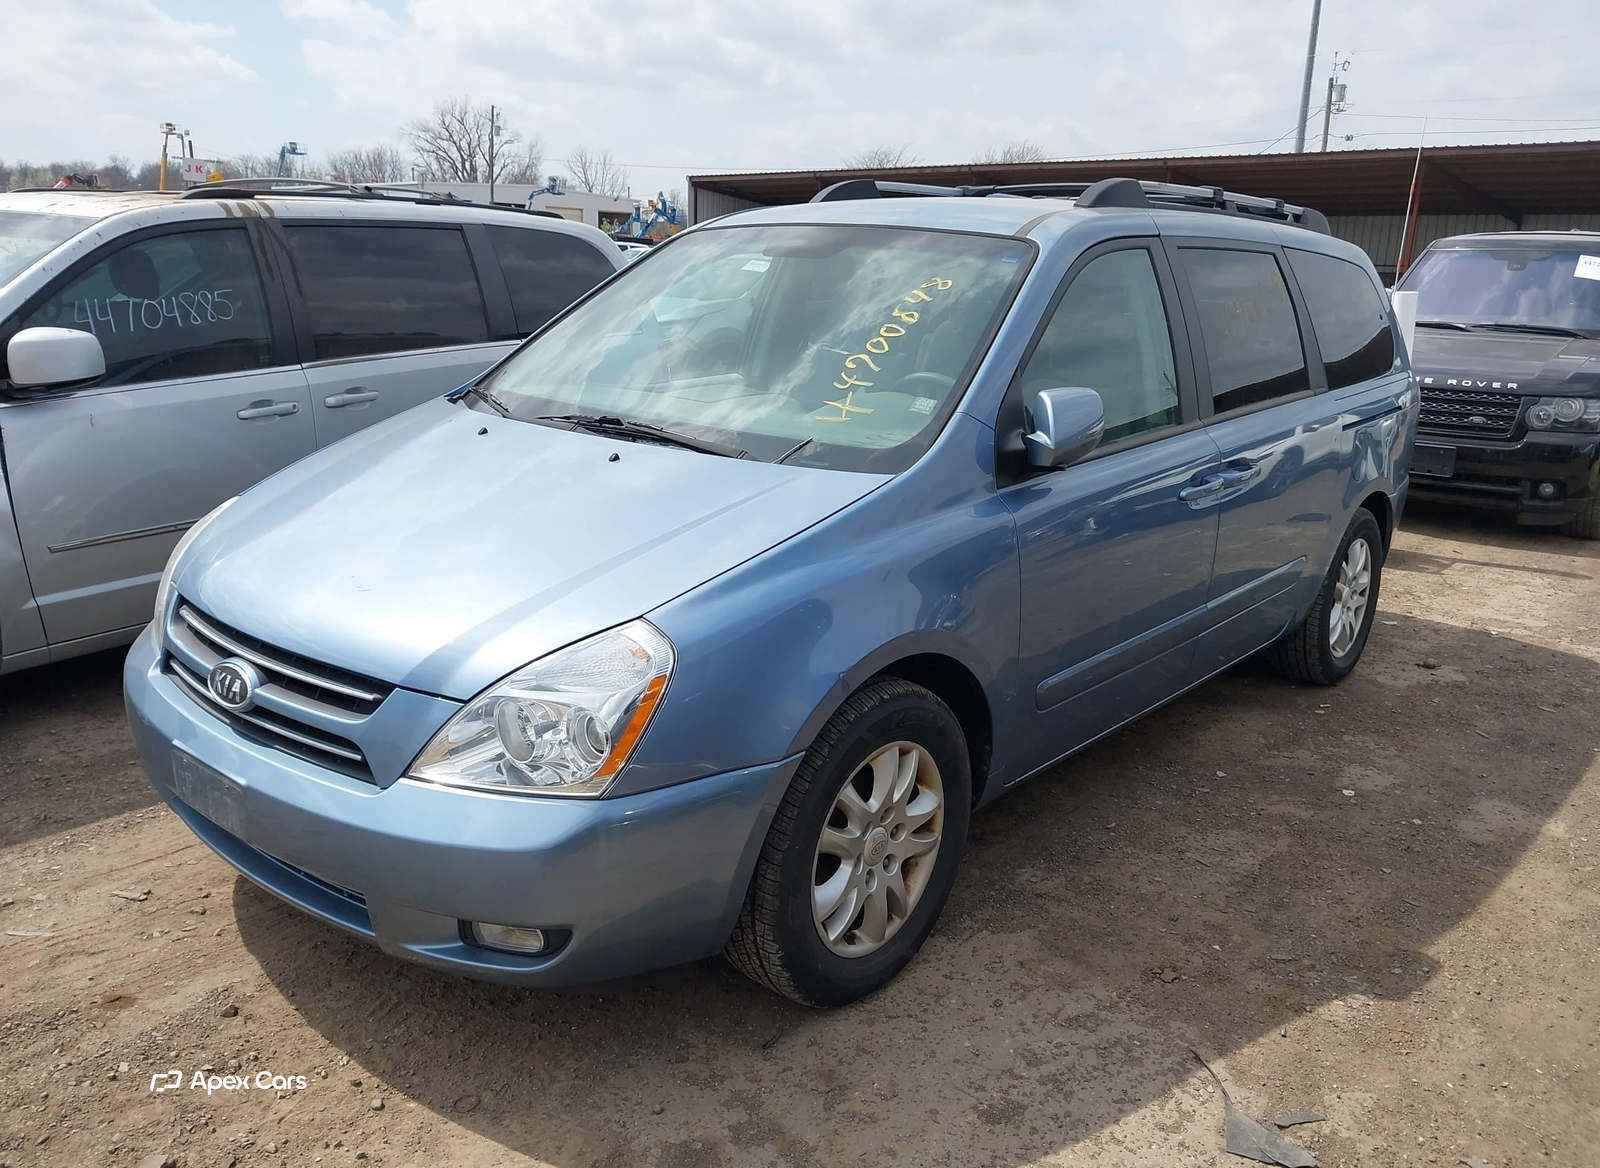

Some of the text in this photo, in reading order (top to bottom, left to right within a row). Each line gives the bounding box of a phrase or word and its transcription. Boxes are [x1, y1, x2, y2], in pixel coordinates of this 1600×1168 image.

[74, 288, 234, 335] 44704885
[1447, 379, 1518, 390] ROVER
[213, 668, 242, 703] KIA
